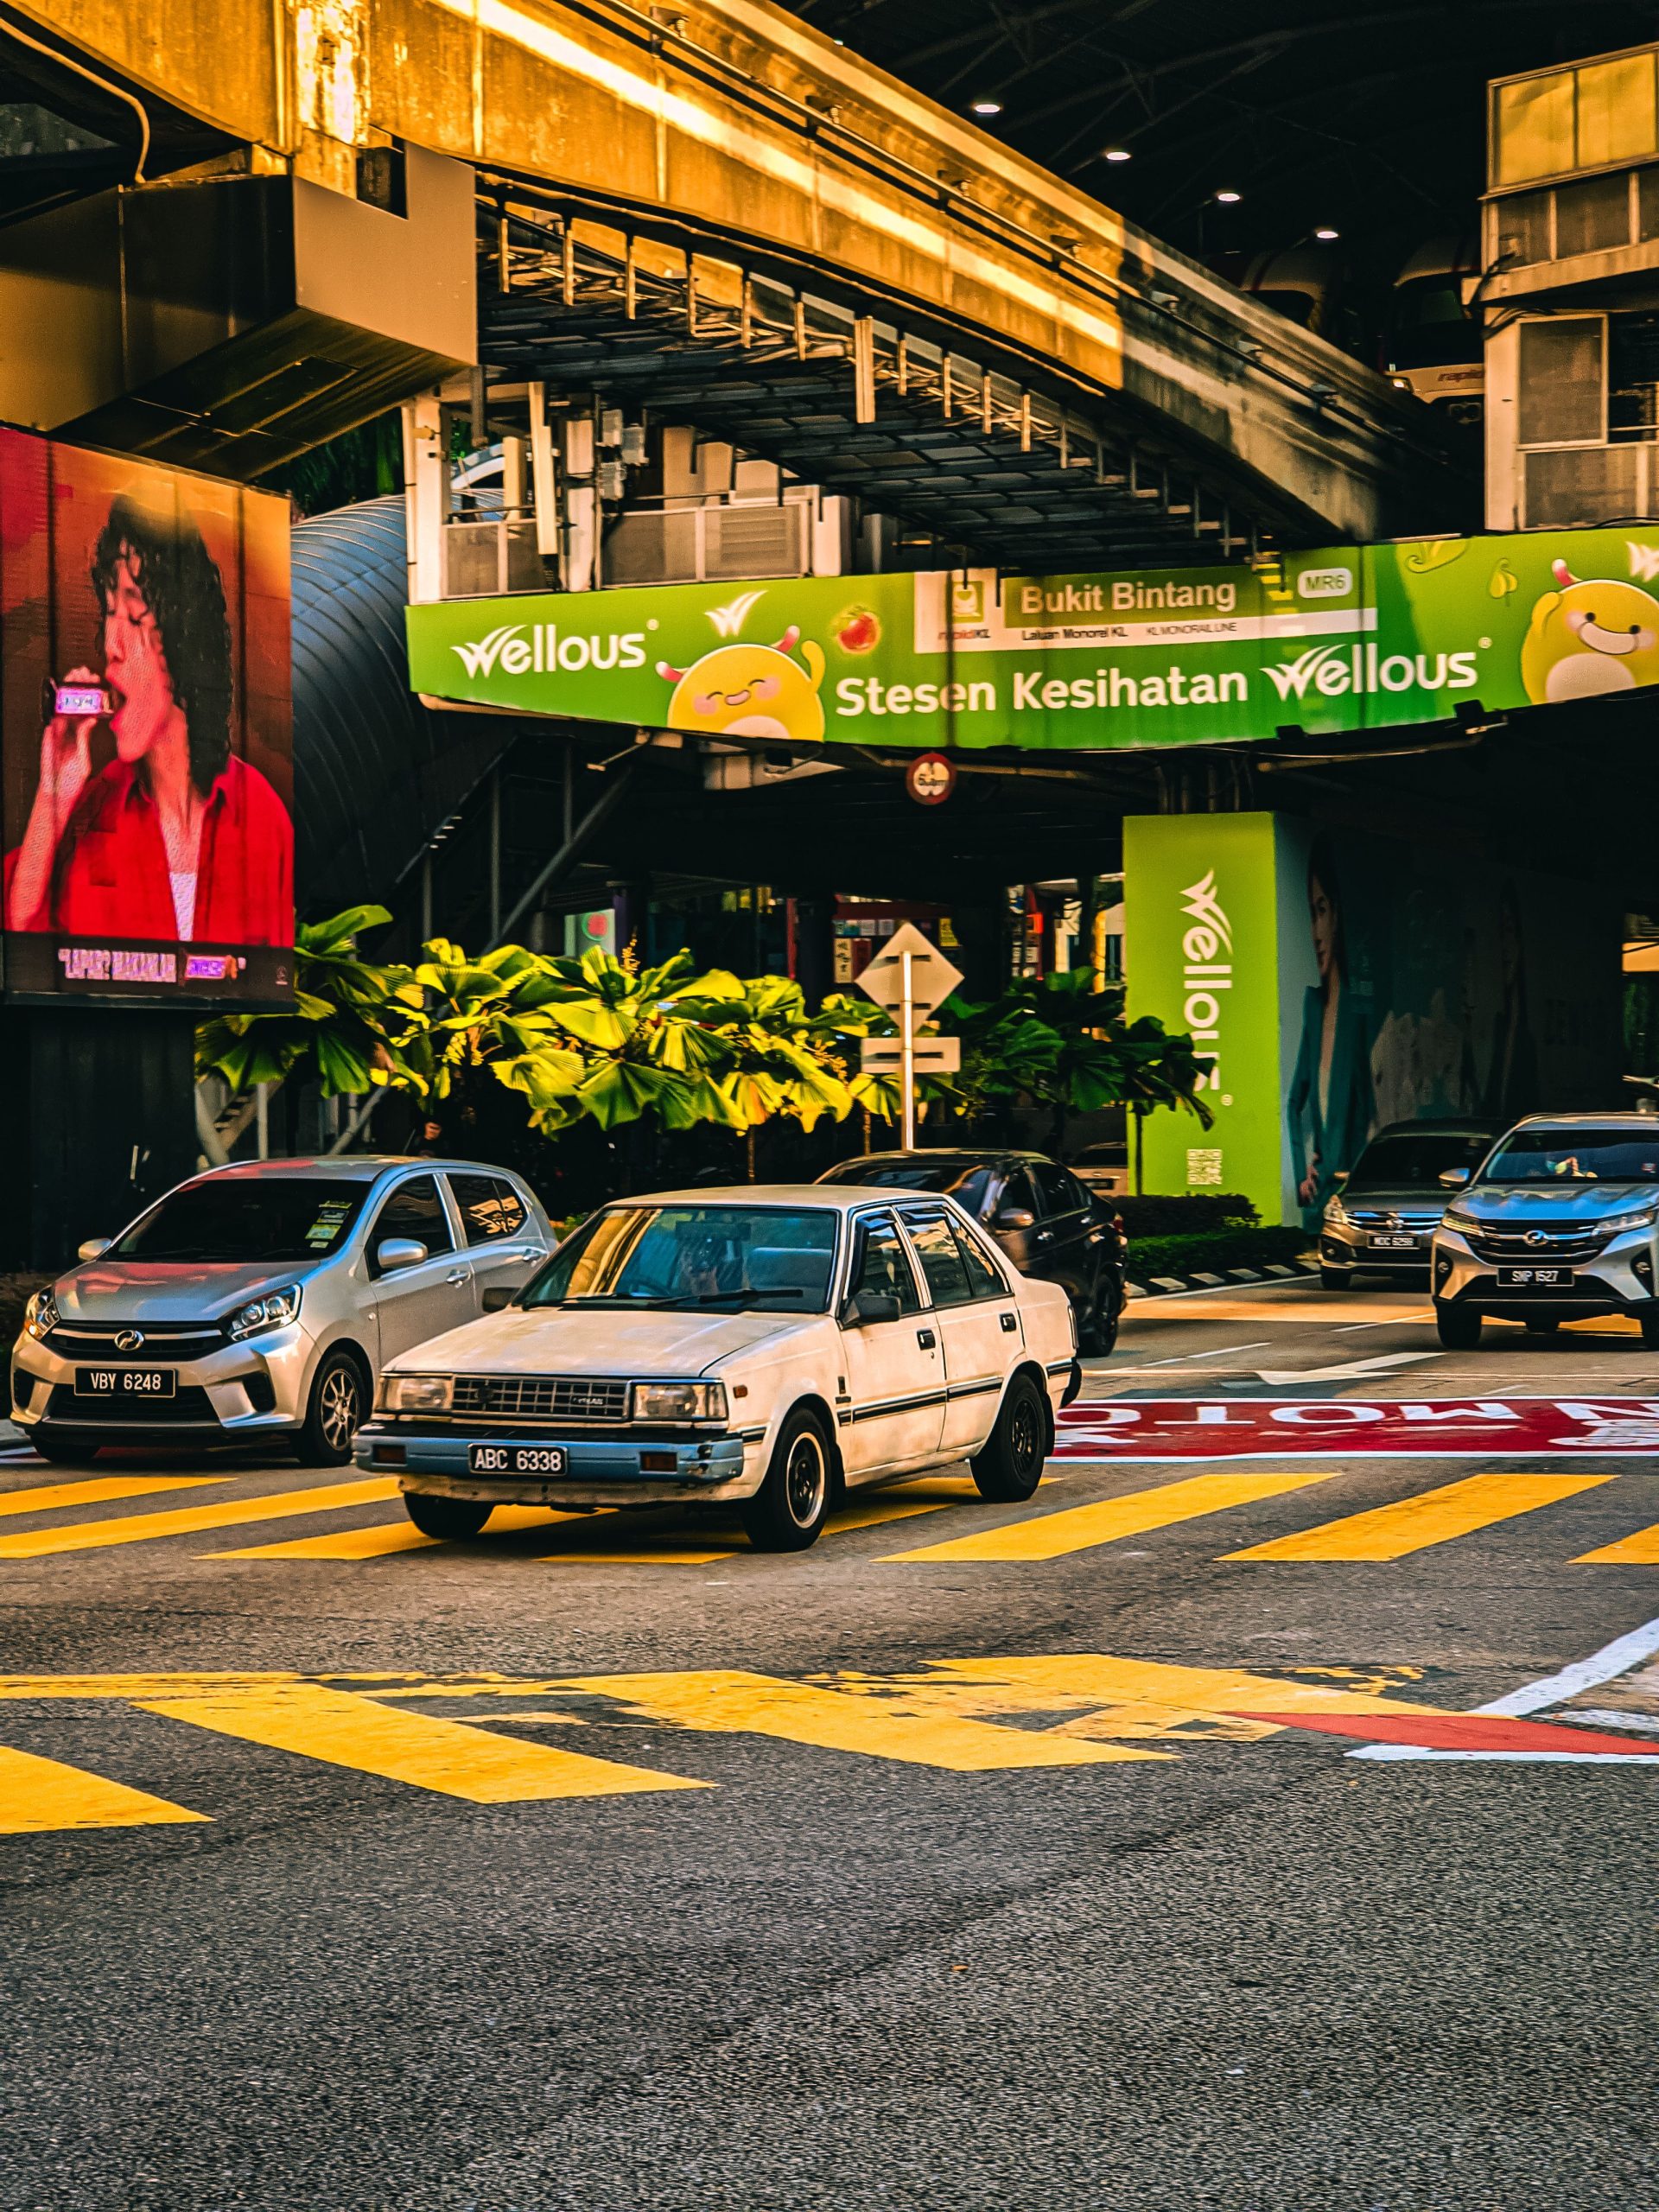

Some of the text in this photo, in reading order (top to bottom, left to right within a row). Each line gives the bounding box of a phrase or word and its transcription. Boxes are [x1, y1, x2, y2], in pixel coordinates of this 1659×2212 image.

[1306, 574, 1344, 591] MR6
[1021, 582, 1236, 613] Bukit Bintang
[1111, 626, 1128, 638] KL
[449, 623, 646, 679] Wellous
[836, 643, 1478, 716] Stesen Kesihatan Wellous
[90, 1372, 162, 1390] VBY 6248
[474, 1448, 562, 1471] ABC 6338
